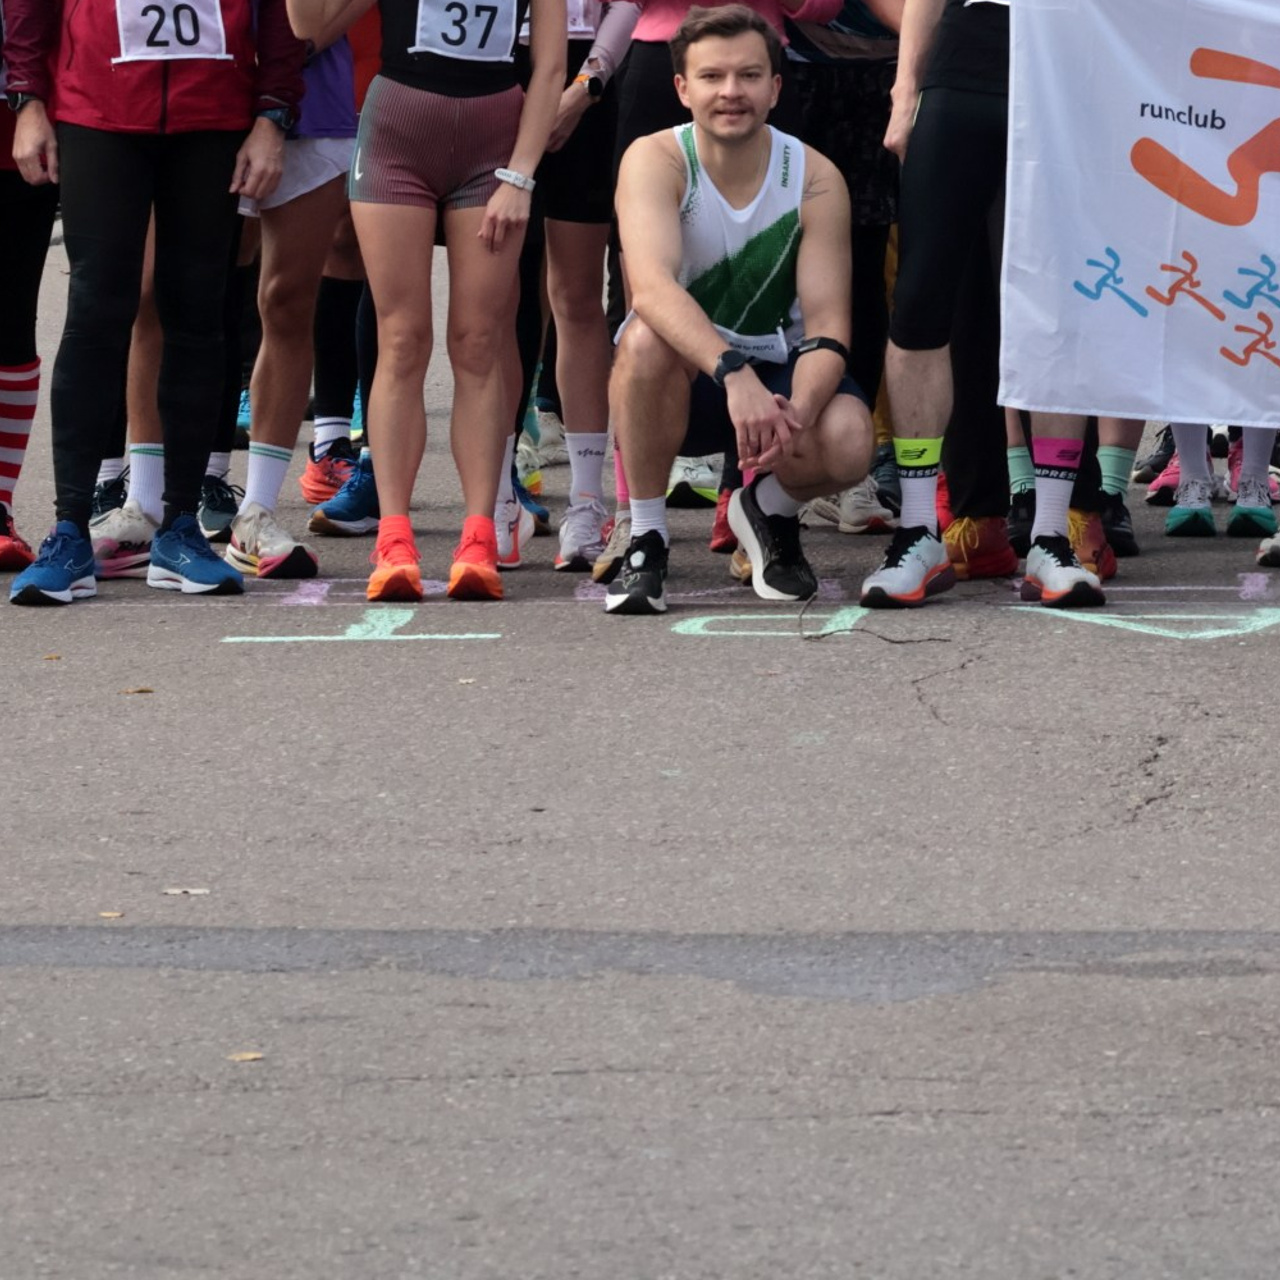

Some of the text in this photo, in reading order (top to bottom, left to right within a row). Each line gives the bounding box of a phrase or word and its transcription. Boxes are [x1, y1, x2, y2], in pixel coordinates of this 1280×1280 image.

[141, 3, 200, 47] 20
[441, 1, 498, 49] 37
[1140, 100, 1227, 132] runclub
[780, 144, 791, 188] INSANITY
